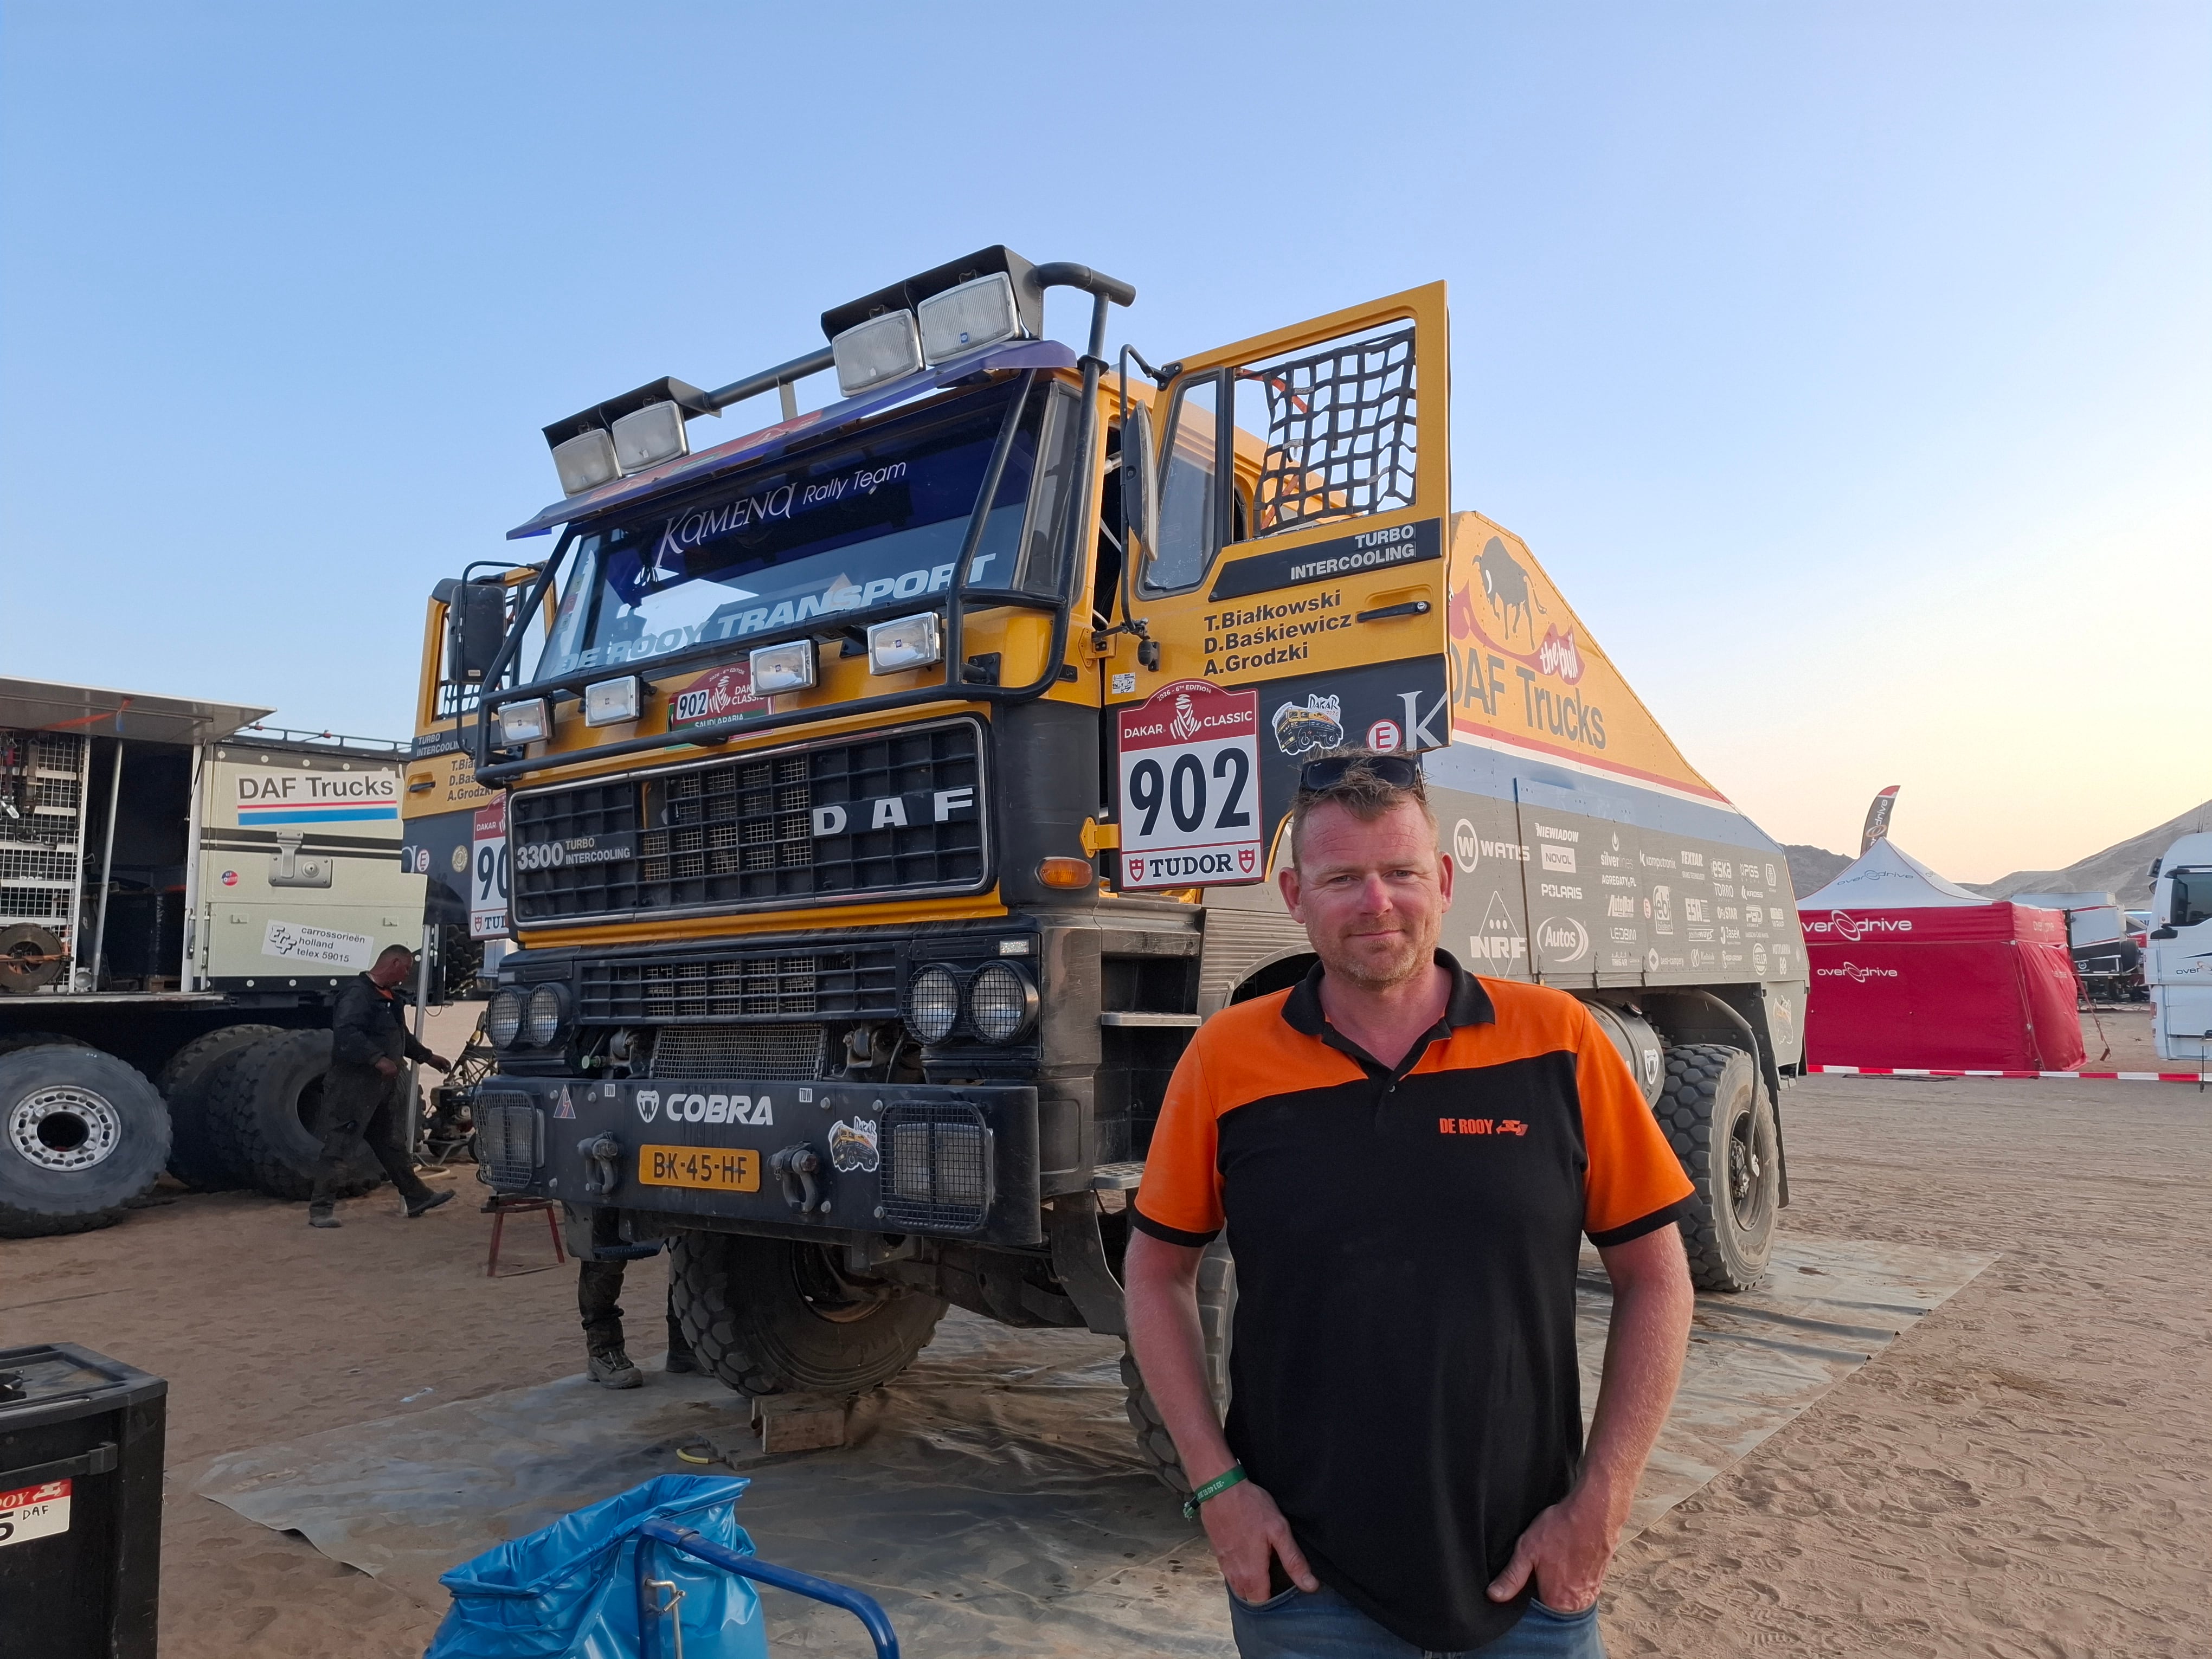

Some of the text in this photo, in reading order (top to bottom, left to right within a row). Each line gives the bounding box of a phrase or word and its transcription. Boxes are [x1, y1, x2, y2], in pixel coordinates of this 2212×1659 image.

[803, 479, 849, 505] Rally
[854, 461, 906, 491] Team
[1355, 525, 1414, 549] TURBO
[1291, 543, 1415, 581] INTERCOOLING
[561, 553, 996, 672] DE ROOY TRANSPORT
[1204, 589, 1341, 632] T.Białkowski
[1204, 613, 1352, 654] D.Baśkiewicz
[1203, 641, 1308, 677] A.Grodzki
[735, 684, 751, 695] DAK
[1156, 690, 1171, 702] 2026
[1186, 684, 1211, 694] EDITION
[679, 692, 707, 718] 902
[1309, 696, 1338, 710] DAKAR
[1516, 665, 1606, 749] Trucks
[1124, 711, 1253, 738] DAKAR CLASSIC
[418, 733, 440, 745] TURBO
[1375, 726, 1392, 749] E
[416, 740, 462, 757] INTERCOOLIN
[239, 776, 394, 799] DAF Trucks
[1129, 747, 1251, 837] 902
[477, 821, 496, 831] DAKAR
[565, 838, 595, 851] TURBO
[1480, 840, 1531, 861] WATIS
[517, 842, 563, 870] 3300
[565, 847, 631, 865] INTERCOOLING
[1149, 853, 1233, 877] TUDOR
[1545, 852, 1572, 865] NOVOL
[1681, 851, 1703, 866] TEXTAR
[477, 844, 507, 901] 90
[1541, 883, 1583, 899] POLARIS
[1713, 882, 1734, 897] TORRO
[1746, 890, 1763, 898] KROSS
[299, 937, 334, 949] holland
[1470, 936, 1527, 959] NRF
[1545, 926, 1576, 948] Autos
[297, 948, 350, 962] telex 59015
[1754, 953, 1767, 964] HELLA
[605, 1085, 615, 1096] TOW
[800, 1090, 812, 1102] TOW
[666, 1093, 773, 1126] COBRA
[1439, 1118, 1494, 1134] DE ROOY
[654, 1152, 748, 1184] BK-45-HF
[22, 1505, 49, 1521] DAF
